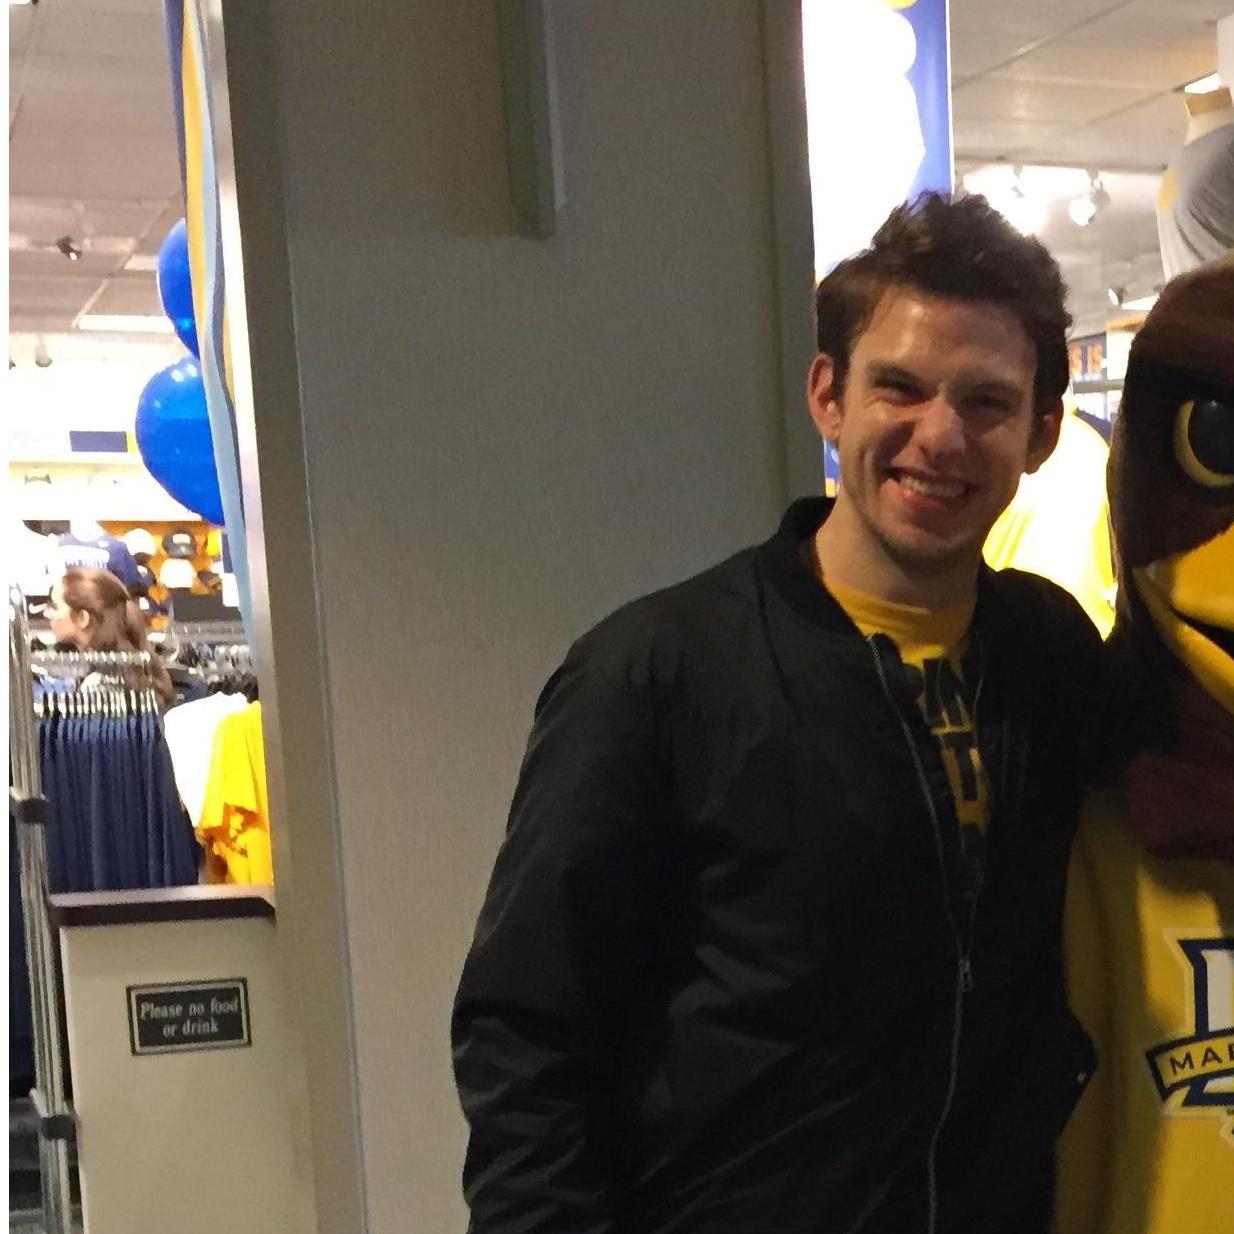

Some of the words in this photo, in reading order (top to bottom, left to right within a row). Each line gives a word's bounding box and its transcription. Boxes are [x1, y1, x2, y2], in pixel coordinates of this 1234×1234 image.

[140, 1001, 182, 1020] Please
[188, 1002, 204, 1016] no
[210, 997, 238, 1014] food
[163, 1023, 176, 1037] or
[182, 1018, 217, 1035] drink
